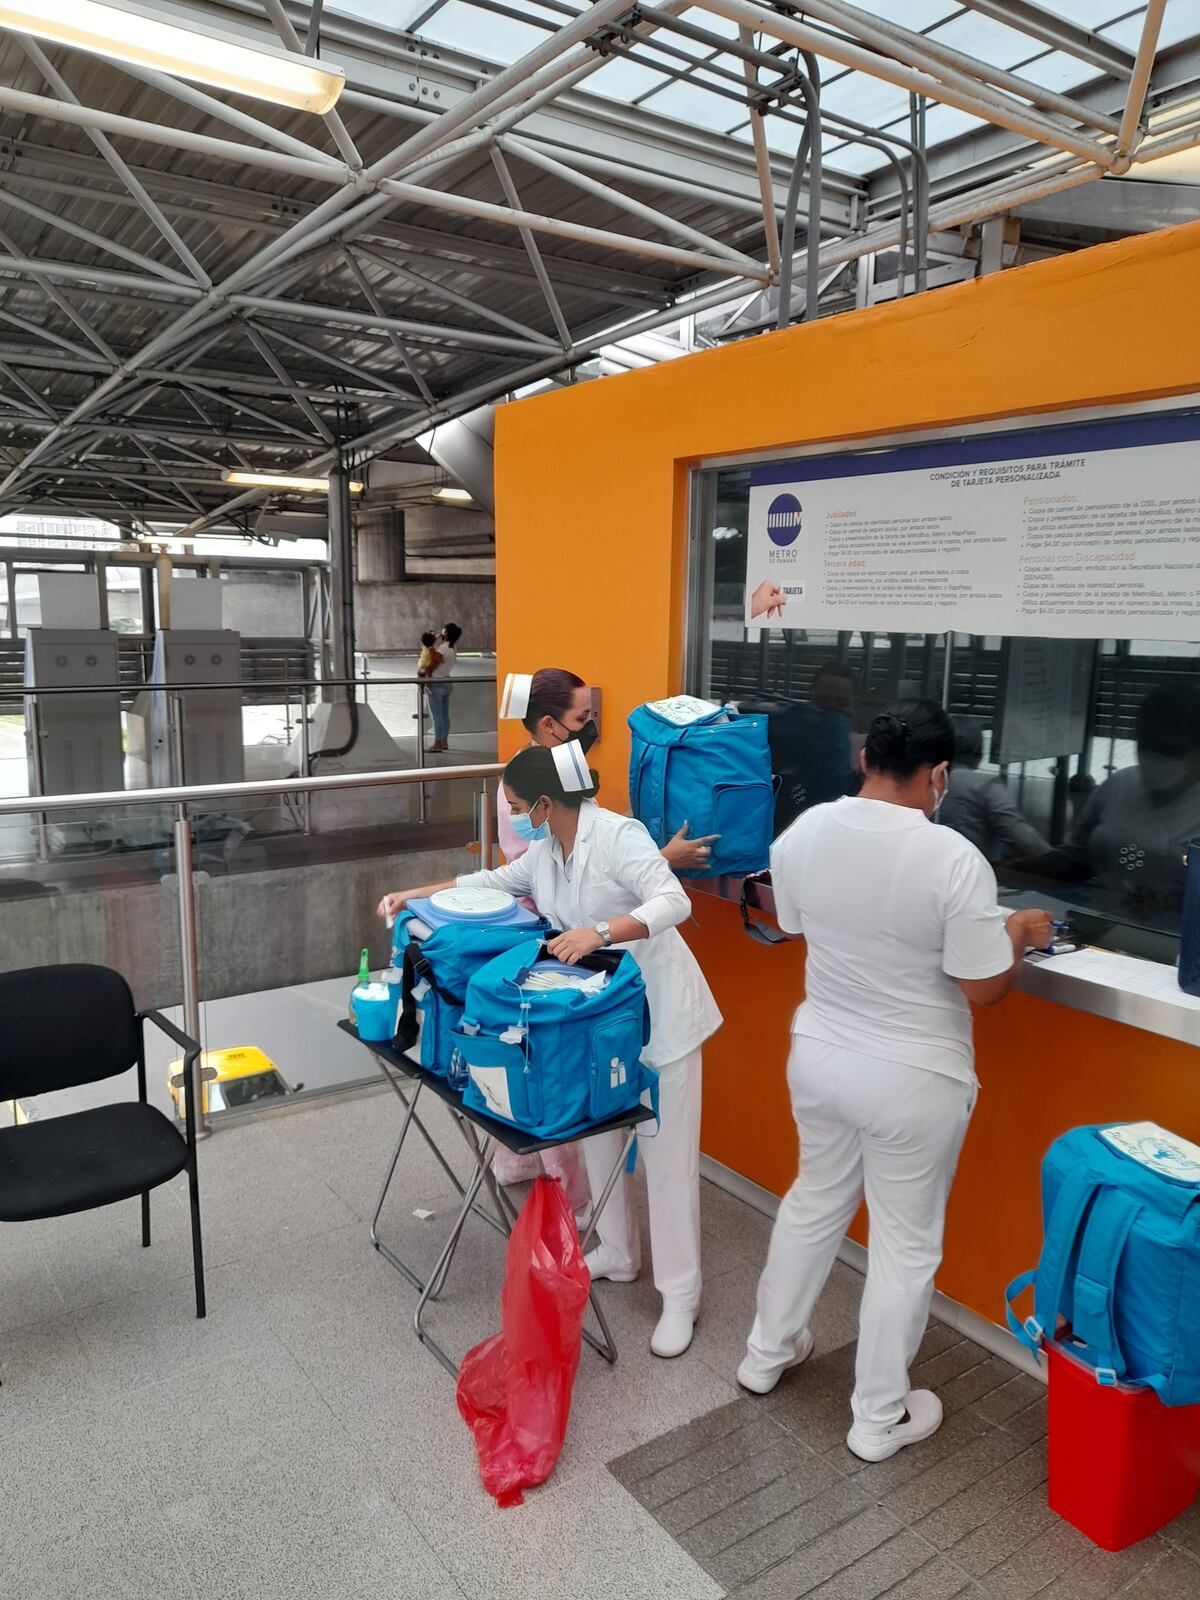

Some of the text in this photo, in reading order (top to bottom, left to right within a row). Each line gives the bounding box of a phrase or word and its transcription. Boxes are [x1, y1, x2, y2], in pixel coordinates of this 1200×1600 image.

[930, 470, 971, 481] CONDICIÓN
[979, 465, 1024, 476] REQUISITOS
[1026, 462, 1047, 471] PARA
[1050, 459, 1086, 469] TRÁMITE
[951, 471, 1060, 488] DE TARJETA PERSONALIZADA
[768, 549, 798, 559] METRO
[782, 586, 803, 595] TARJETA
